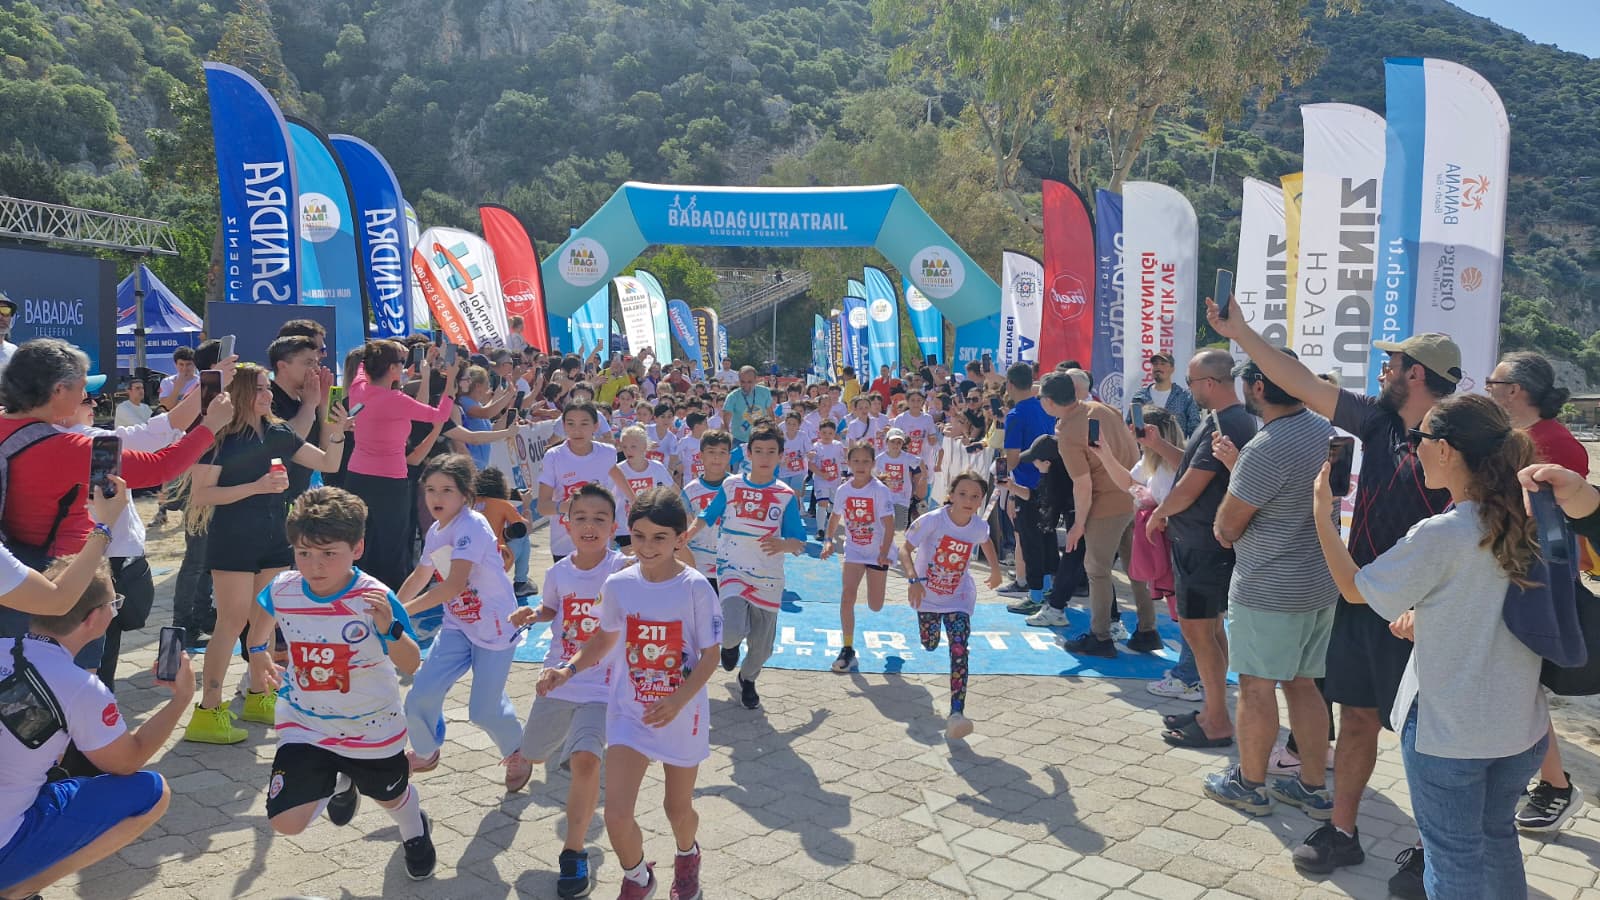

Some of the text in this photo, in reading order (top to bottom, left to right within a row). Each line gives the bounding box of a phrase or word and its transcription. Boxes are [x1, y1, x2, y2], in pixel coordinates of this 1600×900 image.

[432, 294, 446, 310] 612
[25, 298, 84, 325] BABADAĞ
[459, 300, 483, 335] ESNAF
[742, 490, 763, 500] 139
[851, 499, 868, 508] 155
[948, 540, 969, 554] 201
[570, 602, 593, 616] 20
[638, 624, 667, 641] 211
[300, 646, 336, 665] 149
[640, 682, 652, 692] 23
